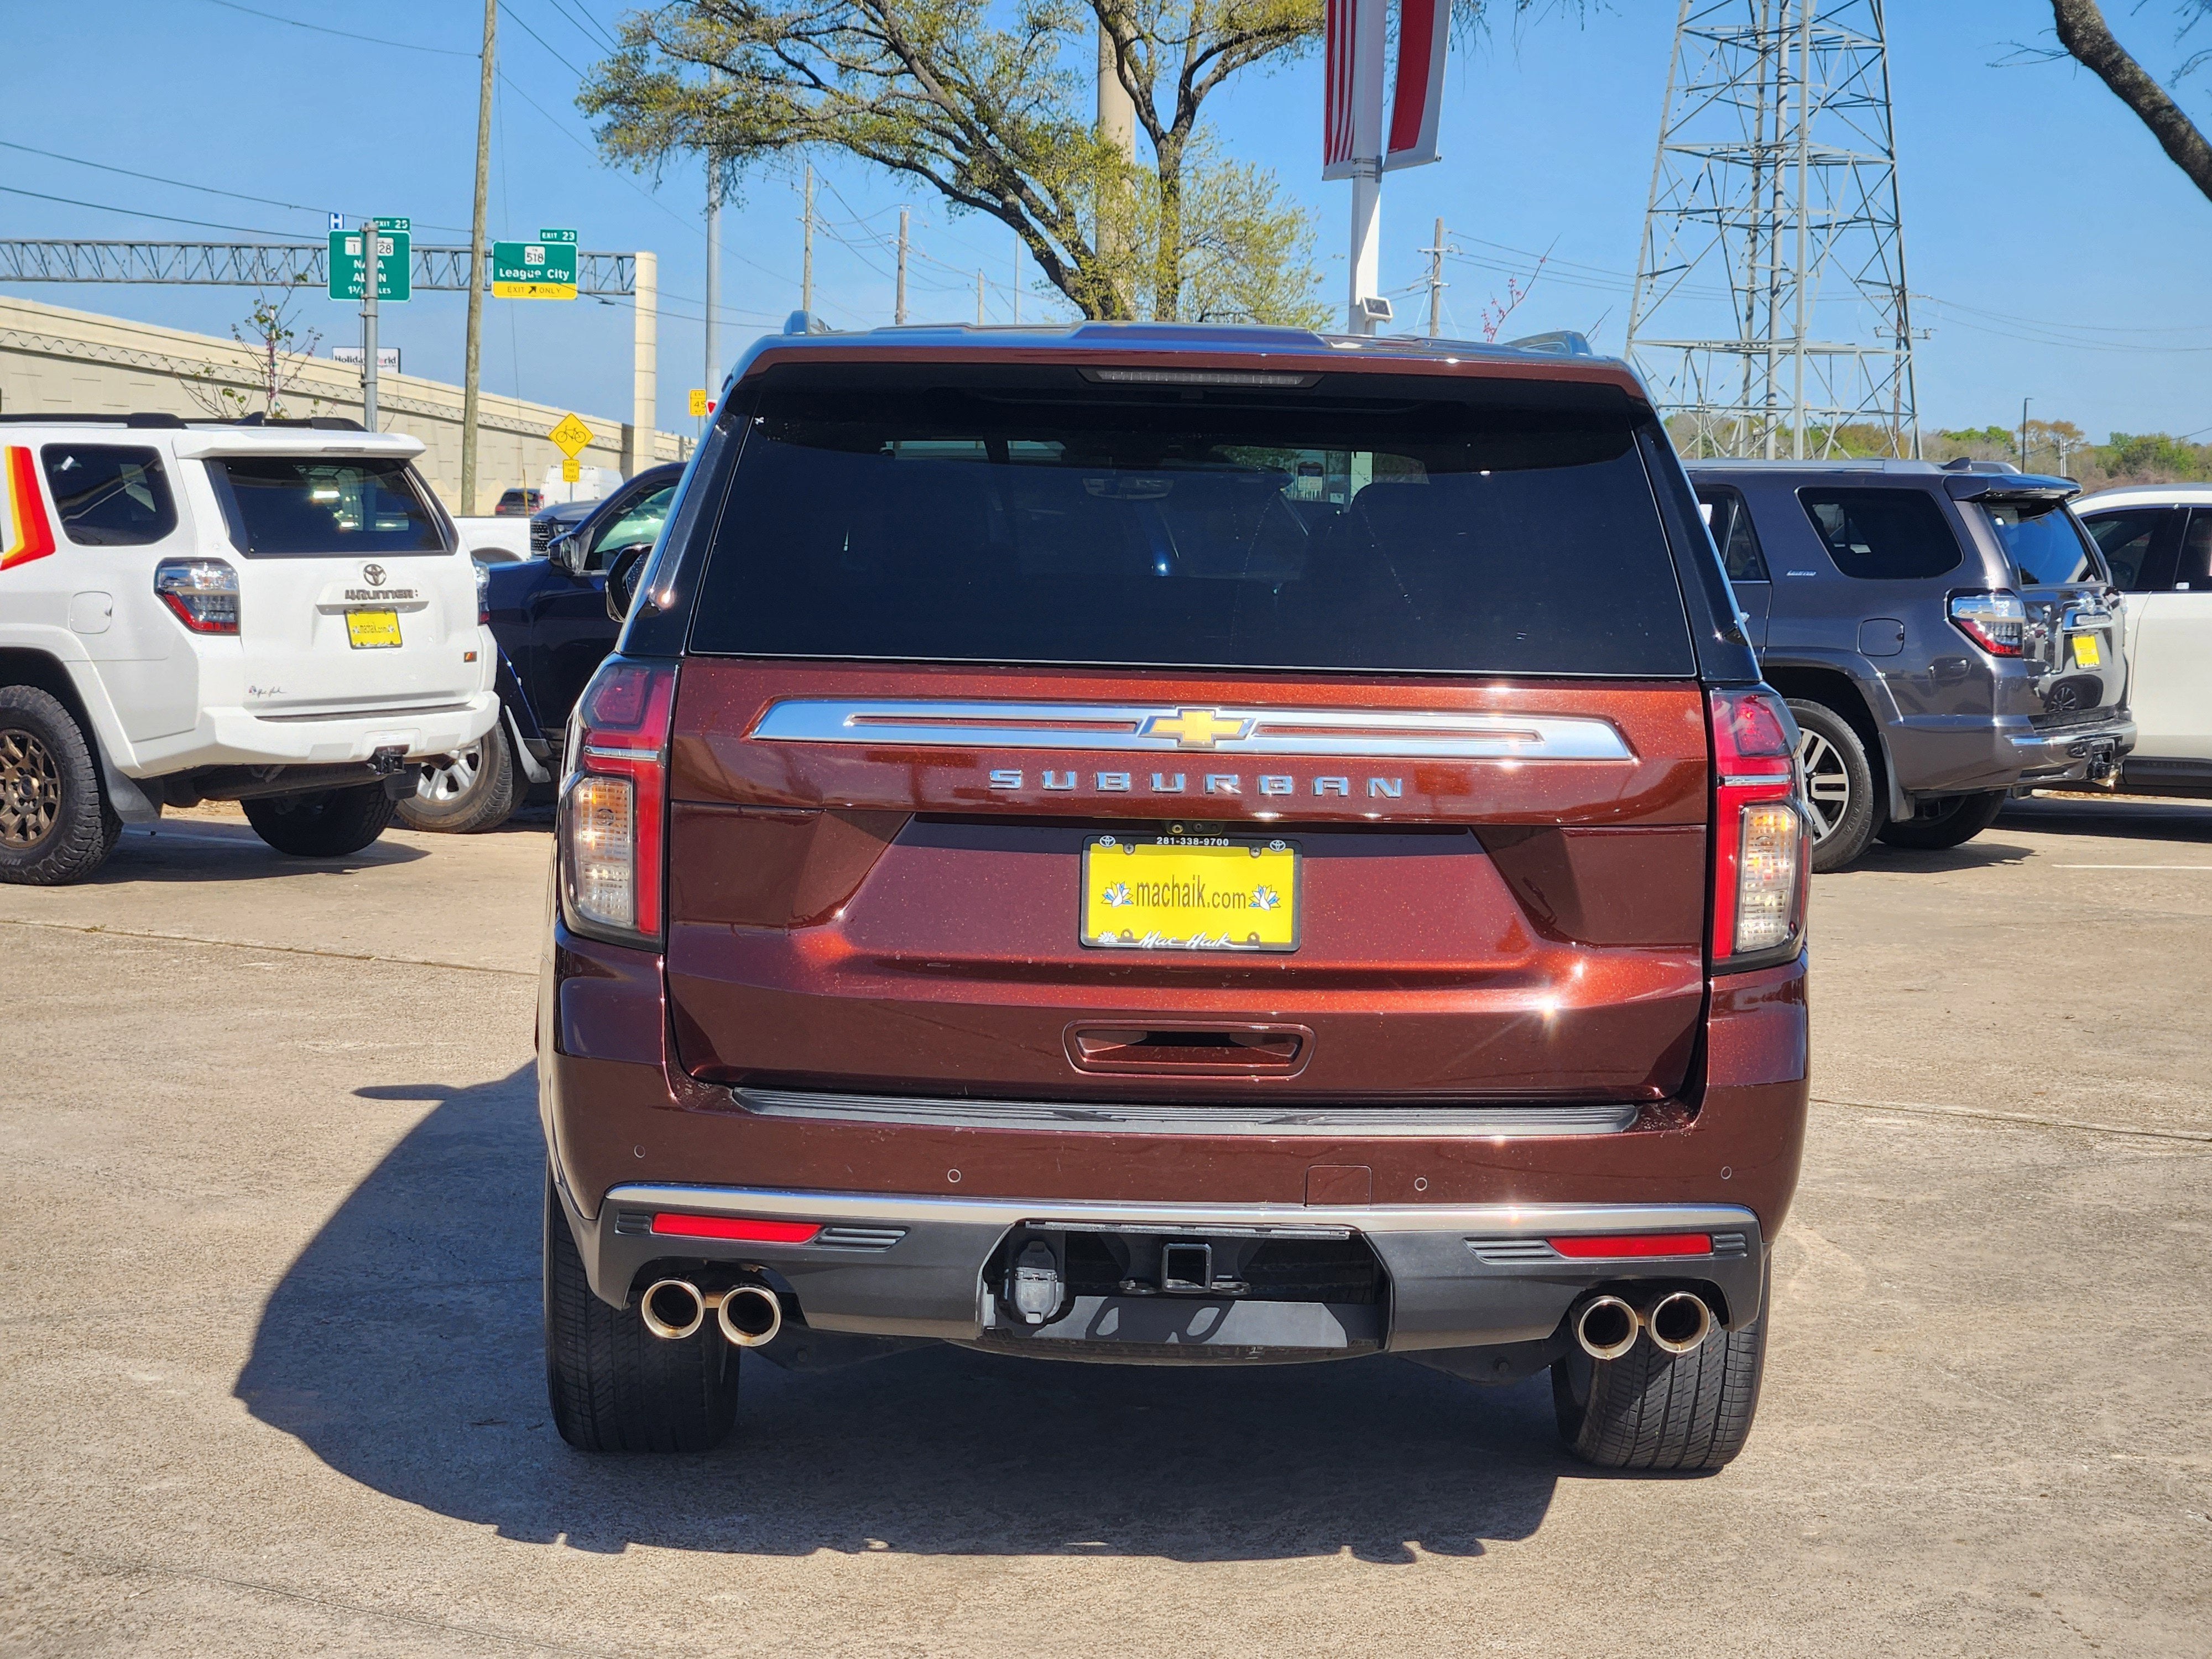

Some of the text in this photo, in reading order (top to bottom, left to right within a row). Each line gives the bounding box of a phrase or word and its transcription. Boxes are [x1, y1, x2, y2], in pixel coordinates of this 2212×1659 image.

[332, 213, 343, 229] H
[395, 220, 408, 229] 25
[562, 232, 575, 241] 23
[353, 244, 356, 253] 1
[379, 244, 392, 254] 28
[527, 253, 544, 263] 518
[353, 259, 384, 269] NA
[353, 272, 387, 283] ALN
[499, 268, 570, 281] League City
[989, 769, 1403, 799] SUBURBAN
[1156, 836, 1229, 847] 281-338-9700
[1136, 874, 1246, 909] machaik.com
[1138, 930, 1185, 948] Mac
